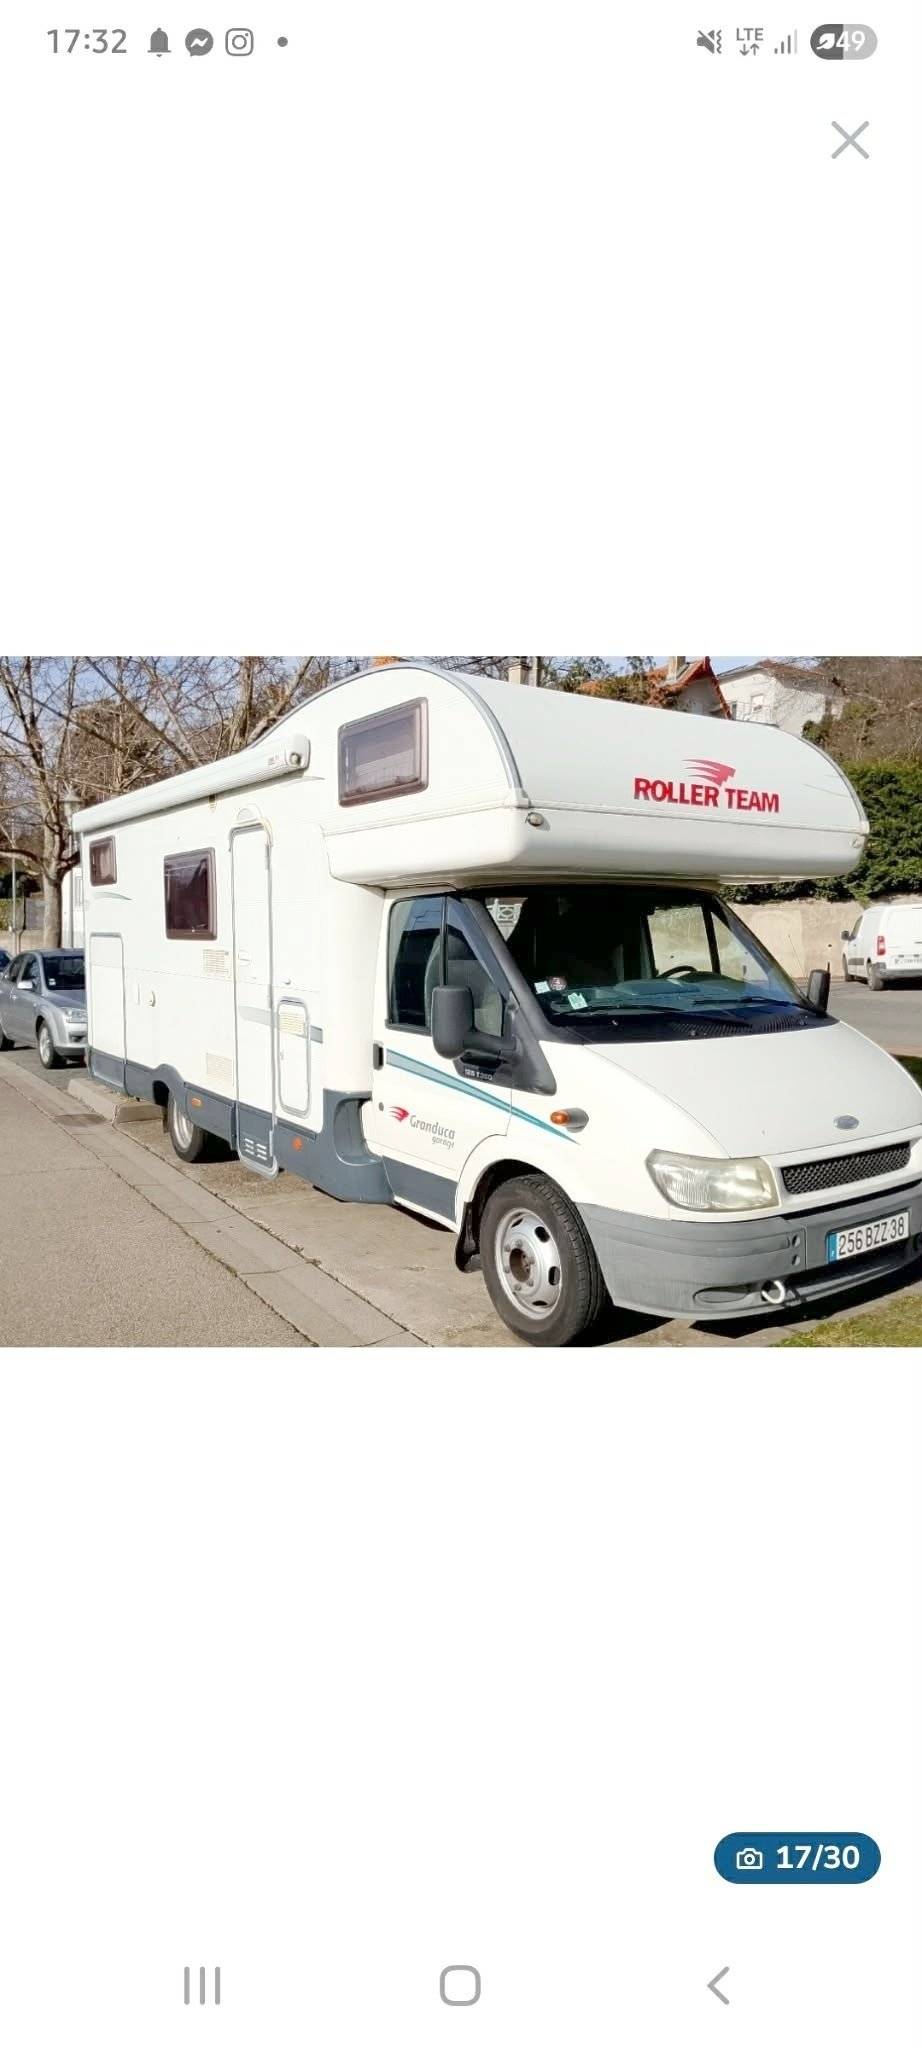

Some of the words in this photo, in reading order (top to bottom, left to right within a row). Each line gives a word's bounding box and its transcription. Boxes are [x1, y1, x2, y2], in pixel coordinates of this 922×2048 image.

[634, 778, 719, 807] ROLLER
[725, 788, 780, 813] TEAM
[409, 1115, 455, 1140] Granduca
[839, 1230, 863, 1255] 256
[865, 1222, 888, 1247] BZZ
[889, 1216, 905, 1239] 38
